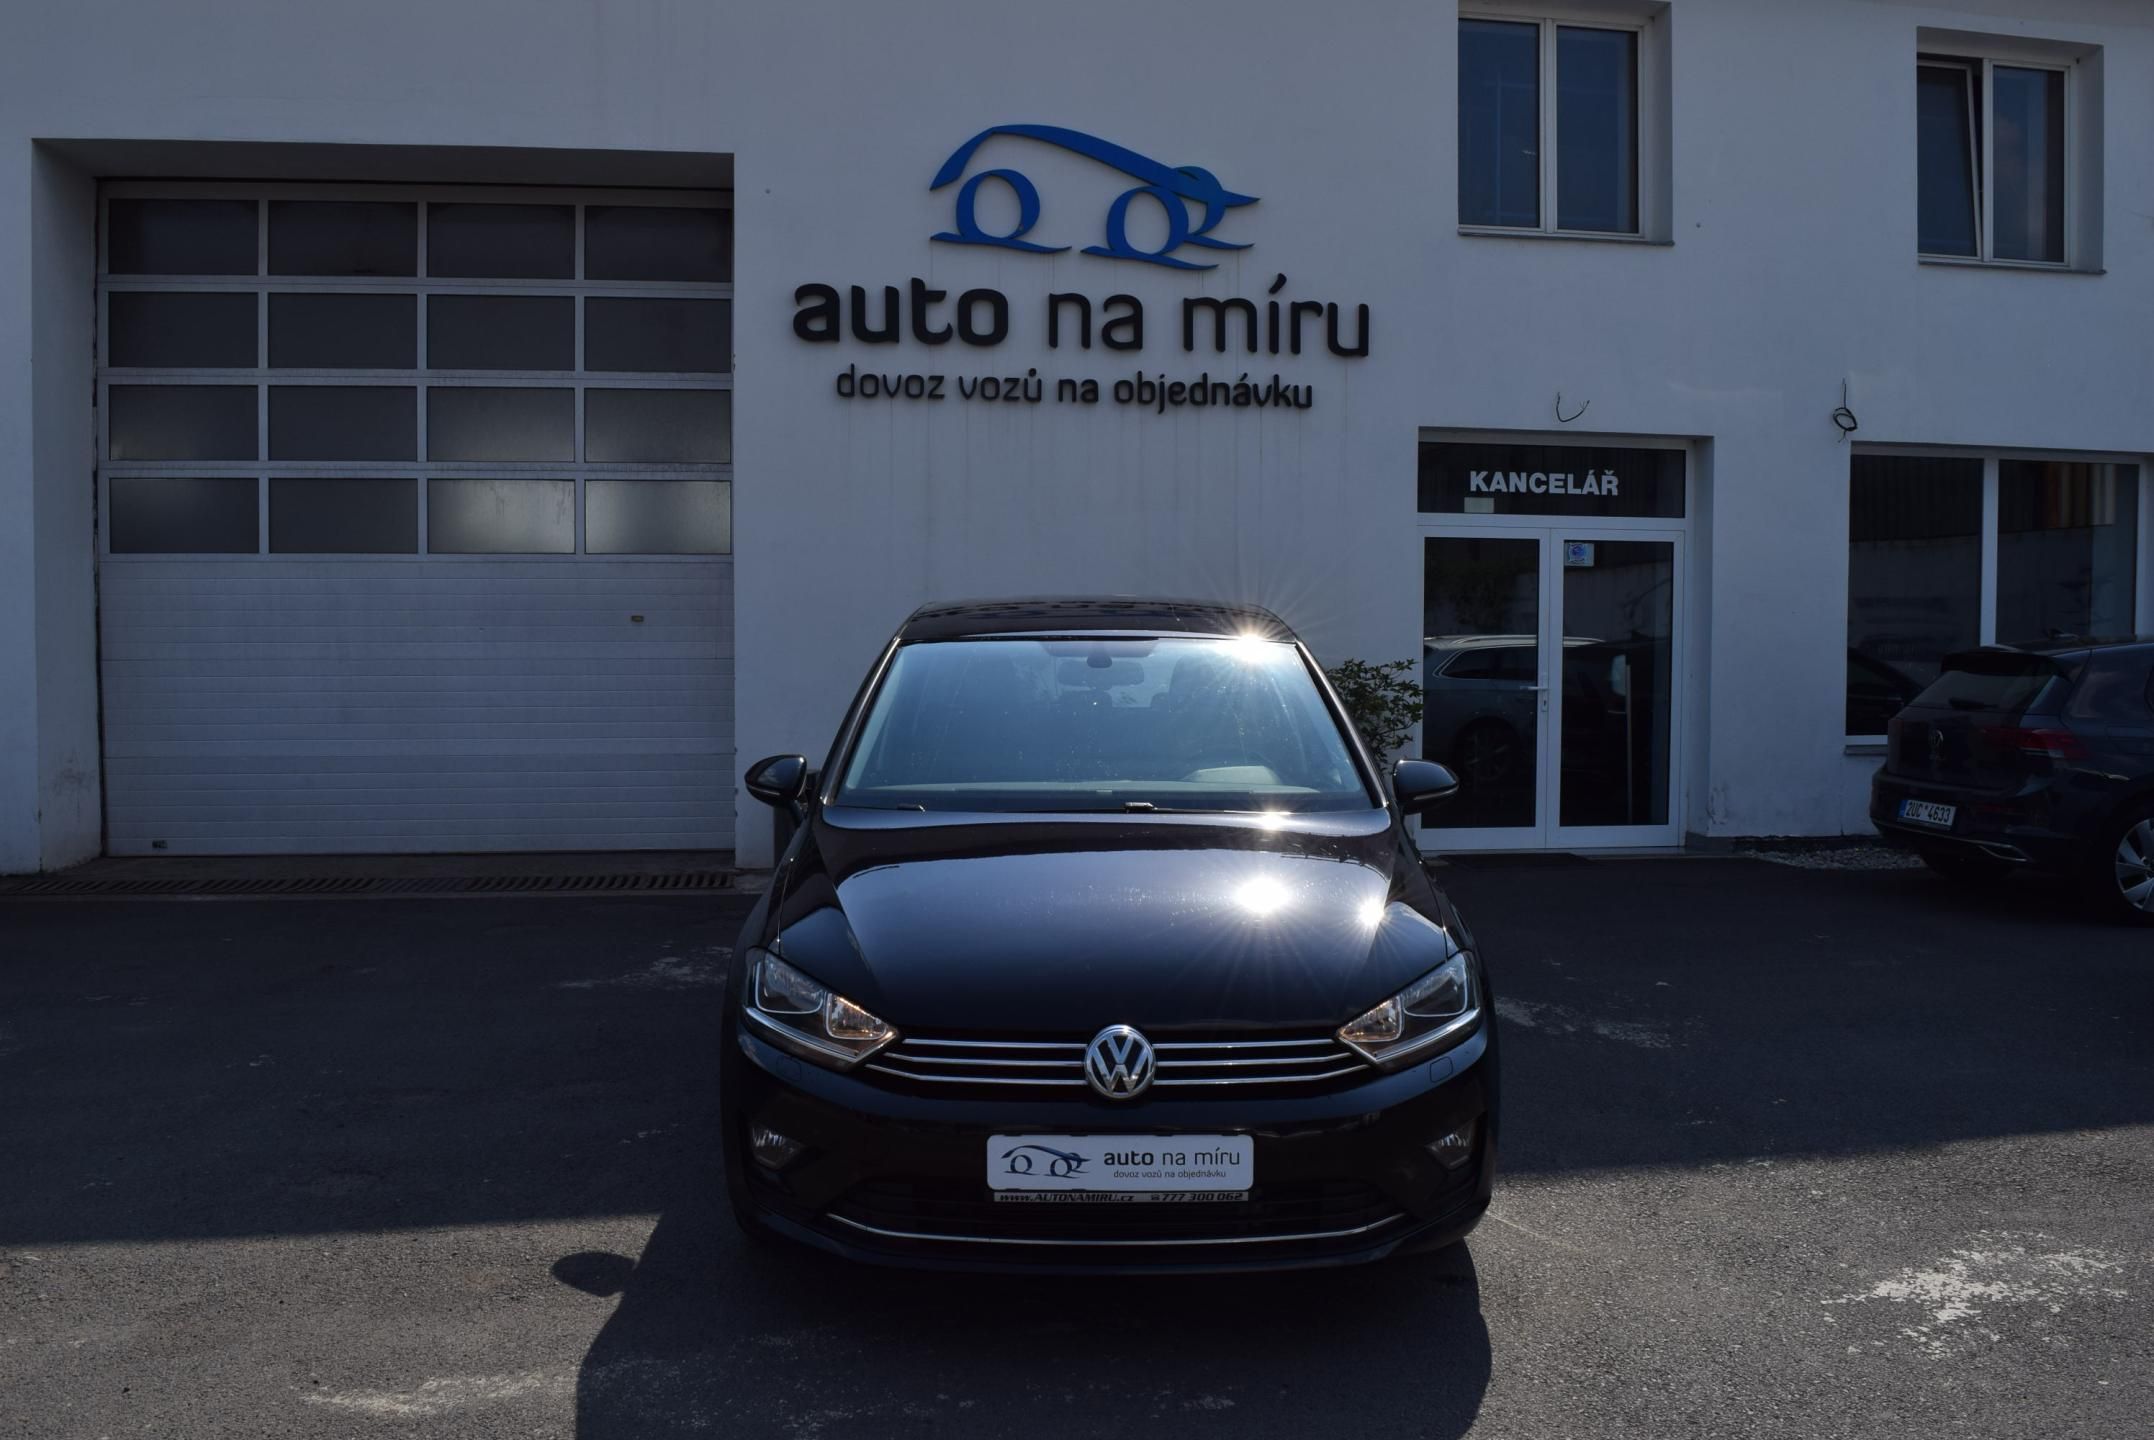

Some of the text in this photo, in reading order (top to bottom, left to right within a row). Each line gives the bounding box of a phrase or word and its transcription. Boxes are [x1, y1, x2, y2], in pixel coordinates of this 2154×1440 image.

[792, 272, 1370, 358] auto na míru
[835, 363, 1313, 415] dovoz vozů na objednávku
[1469, 469, 1619, 496] KANCELÁŘ
[1905, 800, 1951, 823] 2UC 4633
[1103, 1146, 1241, 1167] auto na míru
[1113, 1169, 1227, 1181] dovoz vozů na objednávku
[1162, 1192, 1186, 1202] 777
